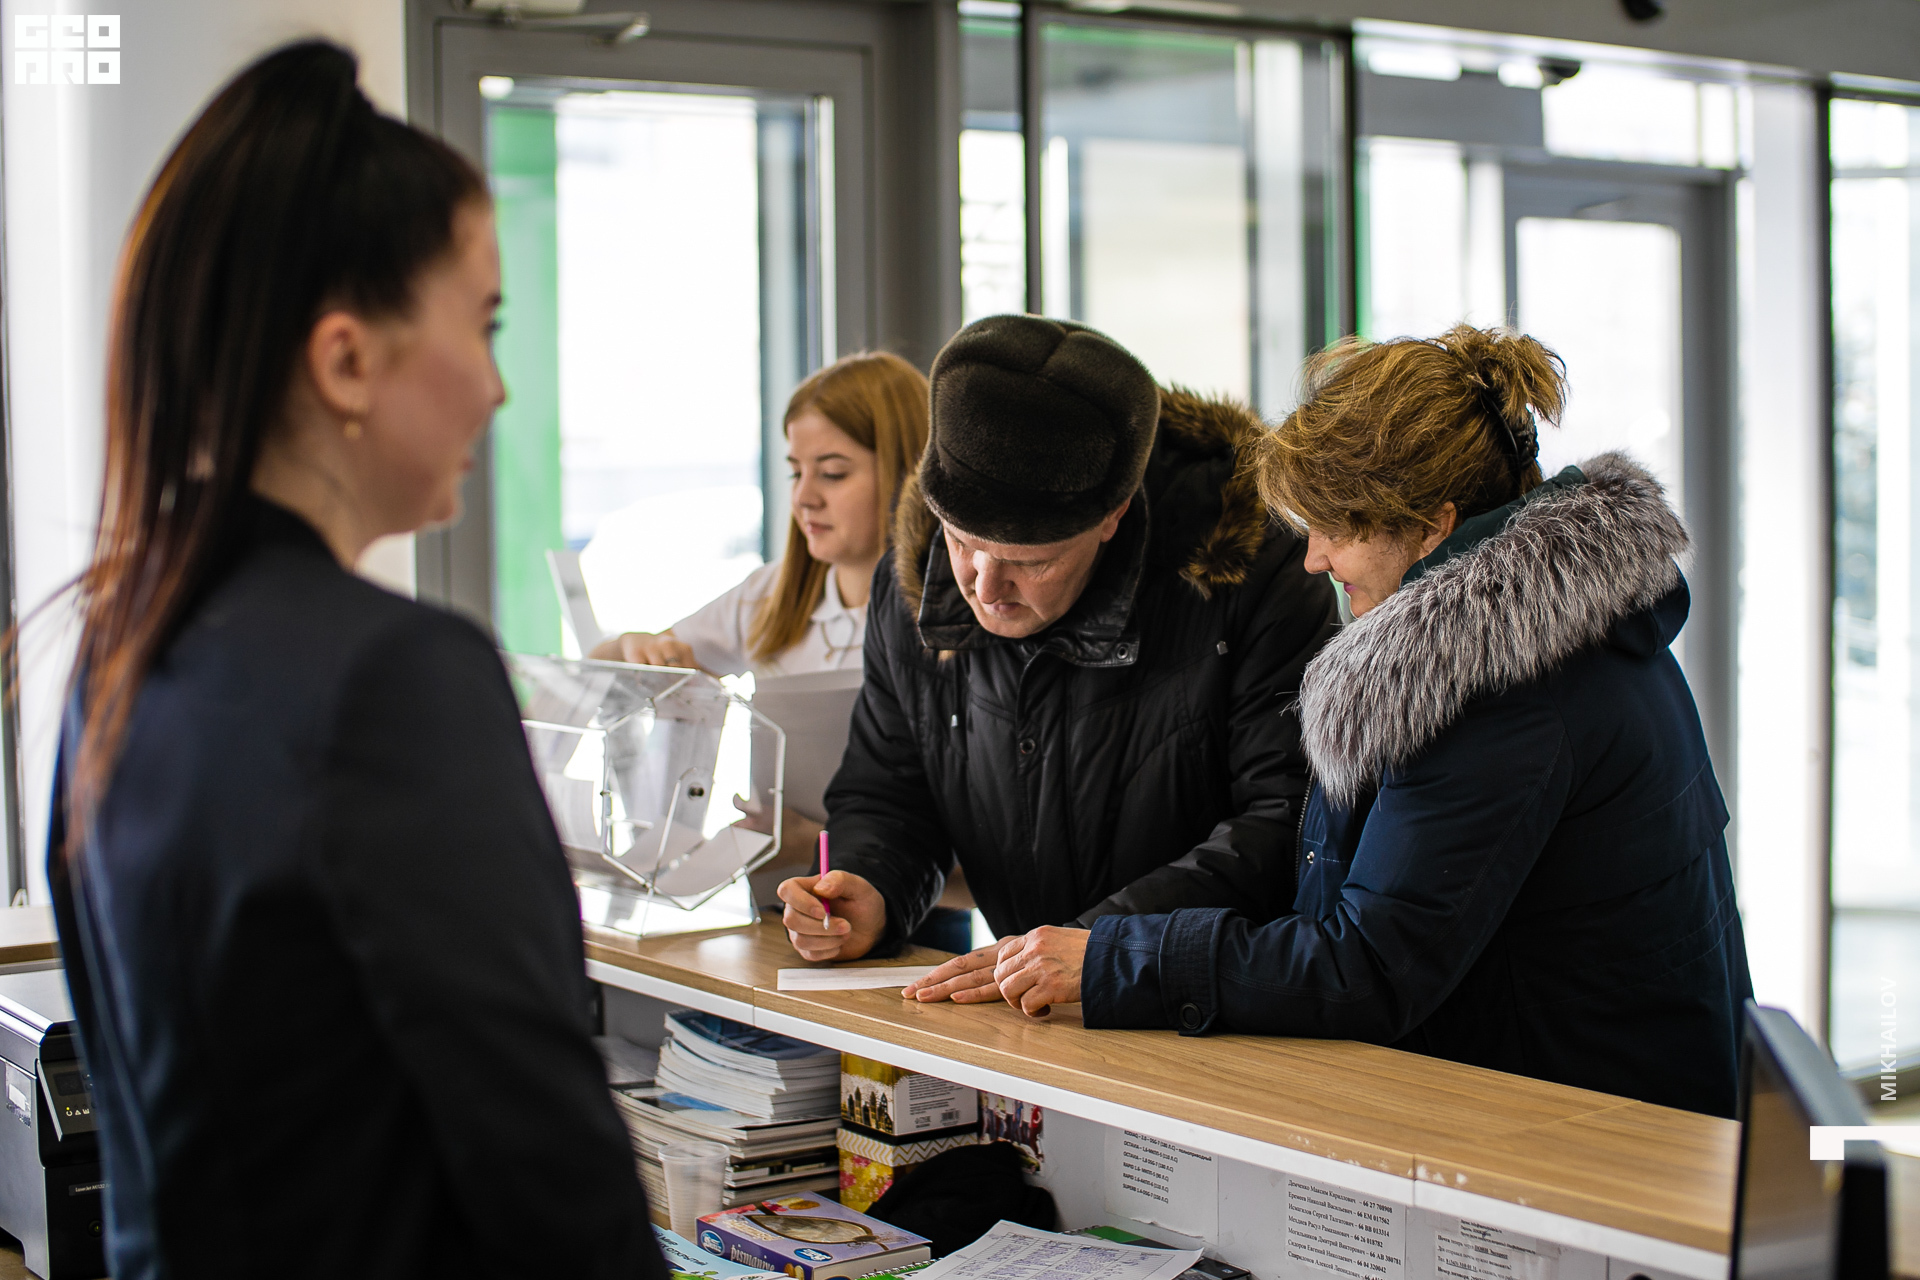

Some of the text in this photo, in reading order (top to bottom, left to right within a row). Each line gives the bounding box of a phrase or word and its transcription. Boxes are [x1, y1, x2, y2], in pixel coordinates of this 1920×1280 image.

[1124, 1141, 1139, 1149] OCTAVIA
[1123, 1151, 1139, 1159] OCTAVIA
[1311, 1186, 1328, 1195] Максим
[1329, 1191, 1355, 1203] Кириллович
[1307, 1197, 1326, 1207] Николай
[1328, 1202, 1352, 1214] Васильевич
[1289, 1203, 1311, 1215] Исмагилов
[1313, 1210, 1328, 1219] Сергей
[1329, 1215, 1354, 1227] Талгатович
[1308, 1221, 1321, 1230] Расул
[1322, 1225, 1349, 1238] Рамазанович
[1289, 1228, 1317, 1240] Могильников
[1318, 1236, 1338, 1246] Дмитрий
[1339, 1242, 1365, 1255] Викторович
[1288, 1239, 1306, 1249] Сидоров
[1307, 1245, 1325, 1255] Евгений
[1326, 1250, 1352, 1263] Николаевич
[1288, 1251, 1314, 1263] Спиридонов
[1315, 1260, 1333, 1269] Алексей
[1334, 1265, 1360, 1278] Леонидович
